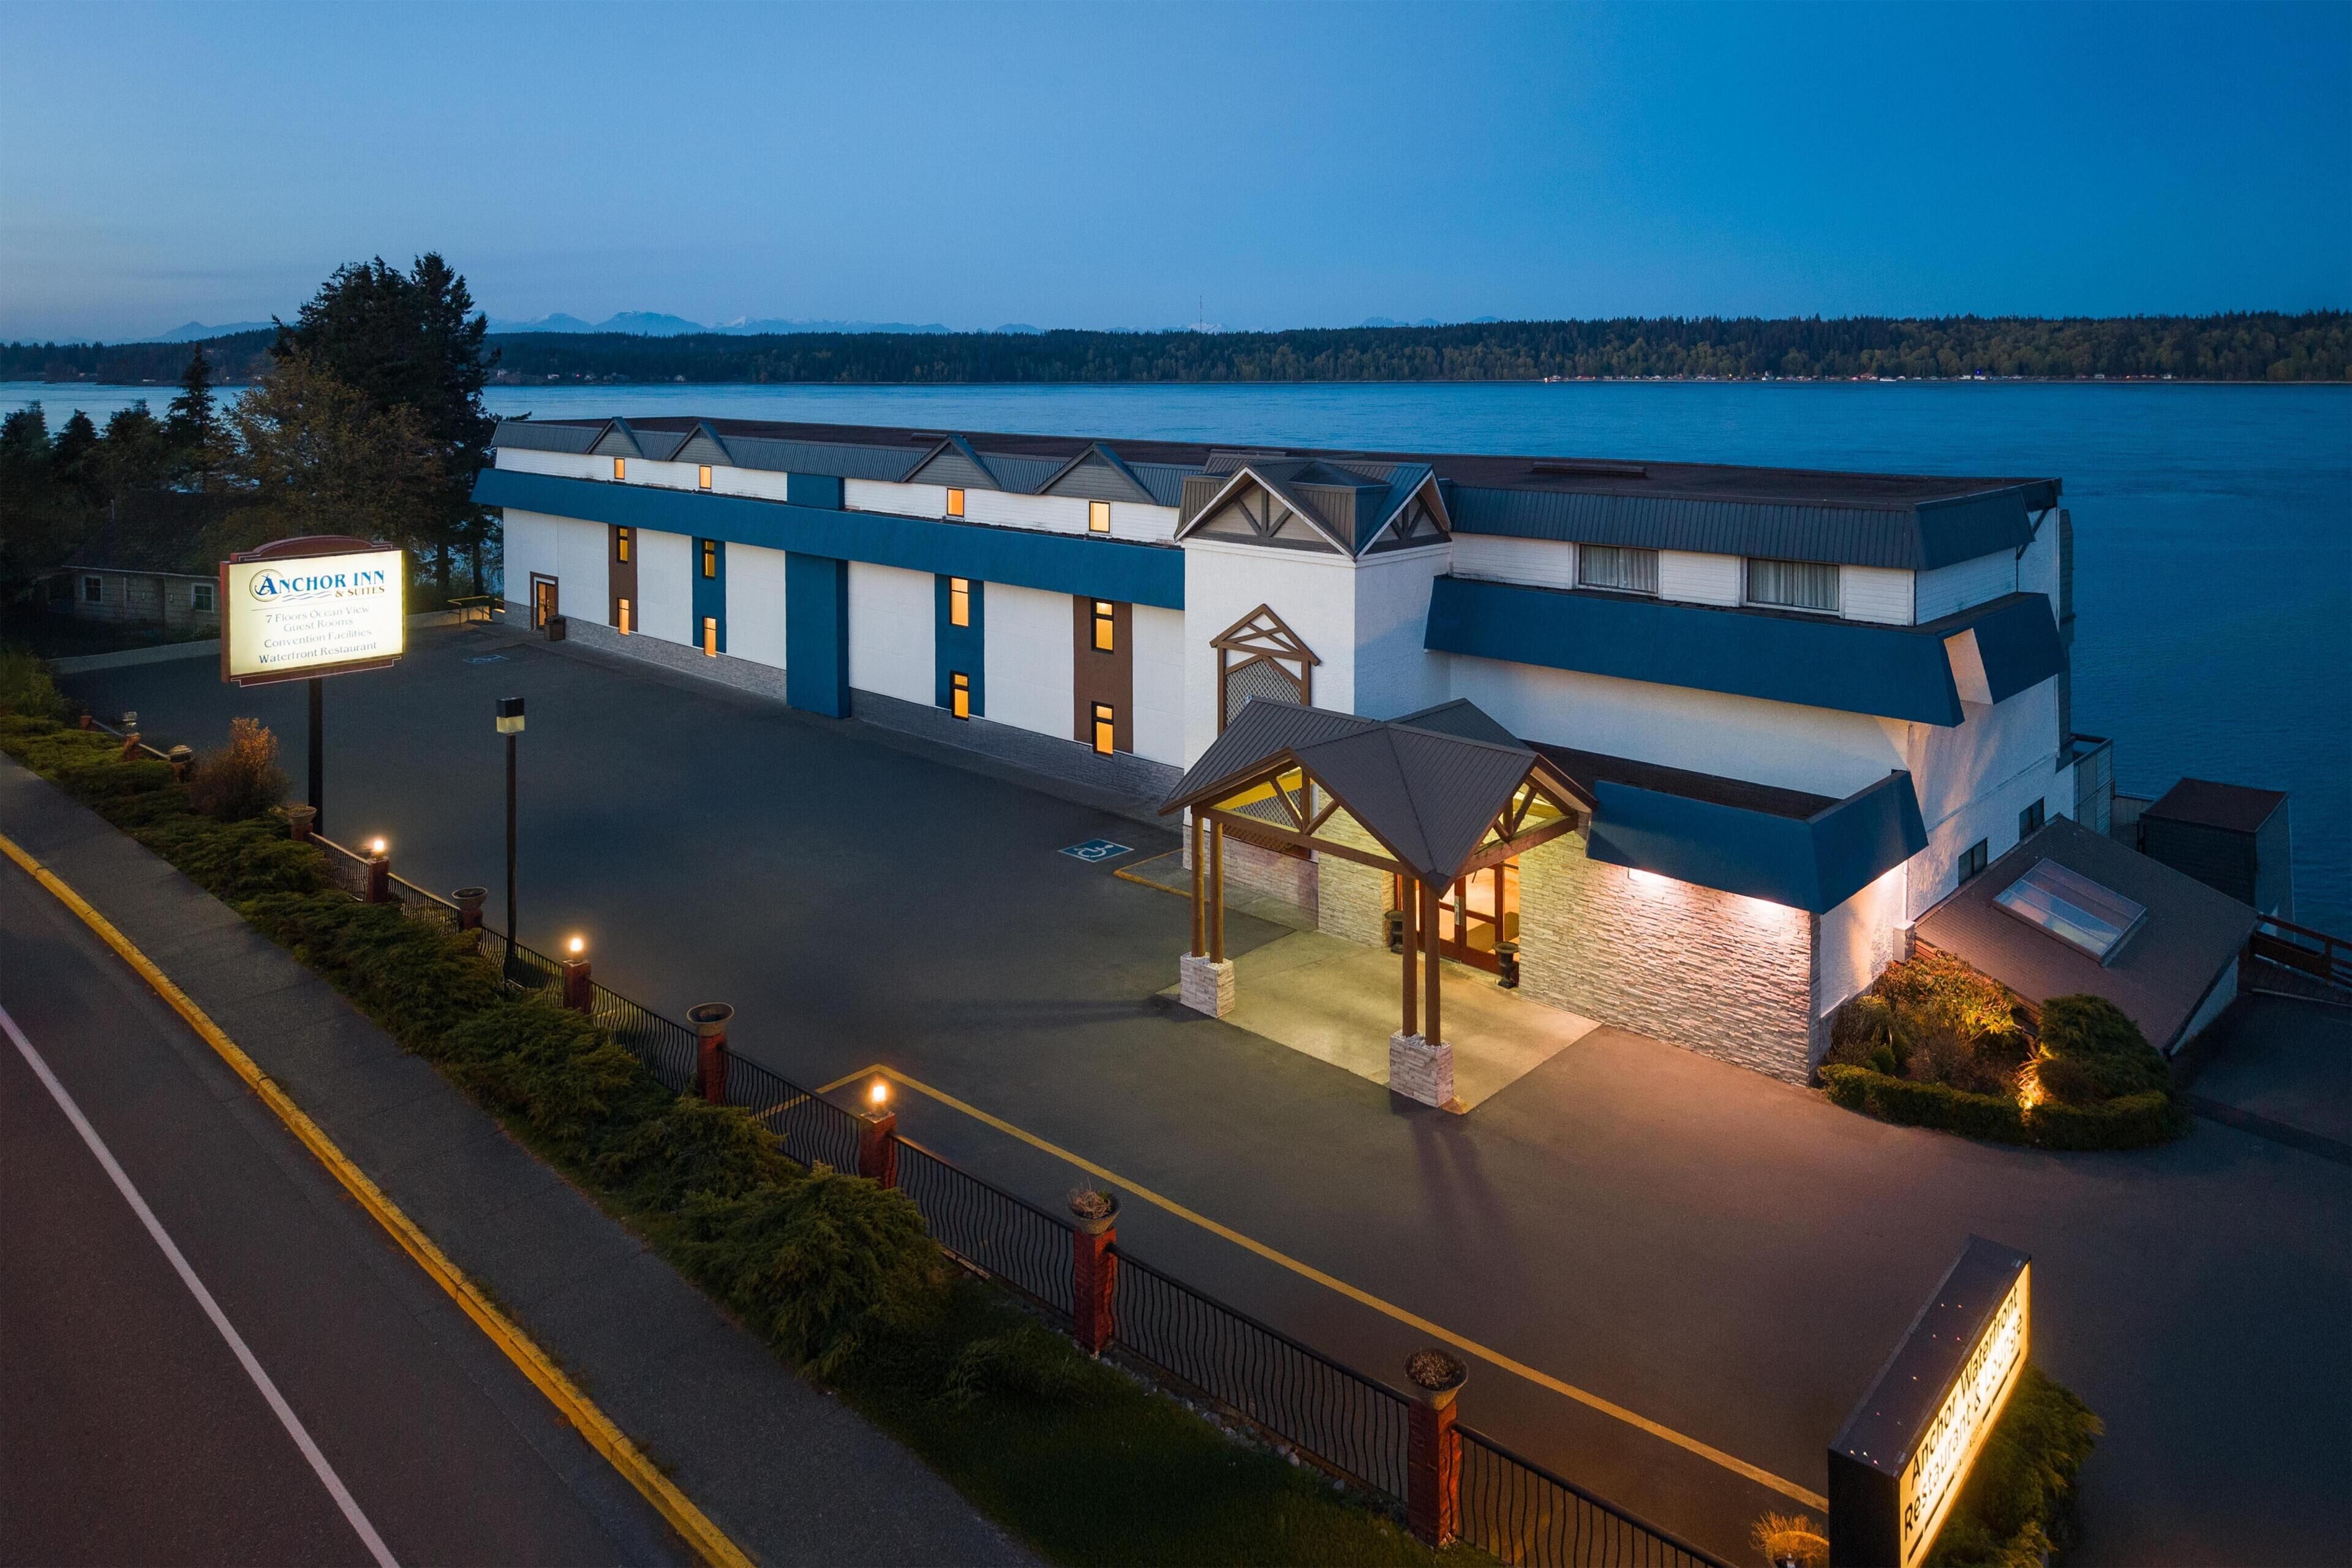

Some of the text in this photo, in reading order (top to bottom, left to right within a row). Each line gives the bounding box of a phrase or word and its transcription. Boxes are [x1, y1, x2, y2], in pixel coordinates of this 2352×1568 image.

[254, 570, 385, 595] ANCHOR INN
[347, 586, 385, 597] SUITES
[276, 614, 307, 622] Floors
[309, 609, 342, 619] Ocean
[345, 606, 370, 614] View
[284, 618, 353, 632] Guest Rooms
[264, 628, 372, 648] Convention Facilities
[259, 641, 377, 663] Waterfront Restaurant
[1911, 1392, 1957, 1491] Anchor
[1961, 1284, 2018, 1400] Waterfront
[1904, 1401, 1970, 1542] Restaurant
[1974, 1381, 1981, 1412] &
[1985, 1313, 2022, 1392] Lounge
